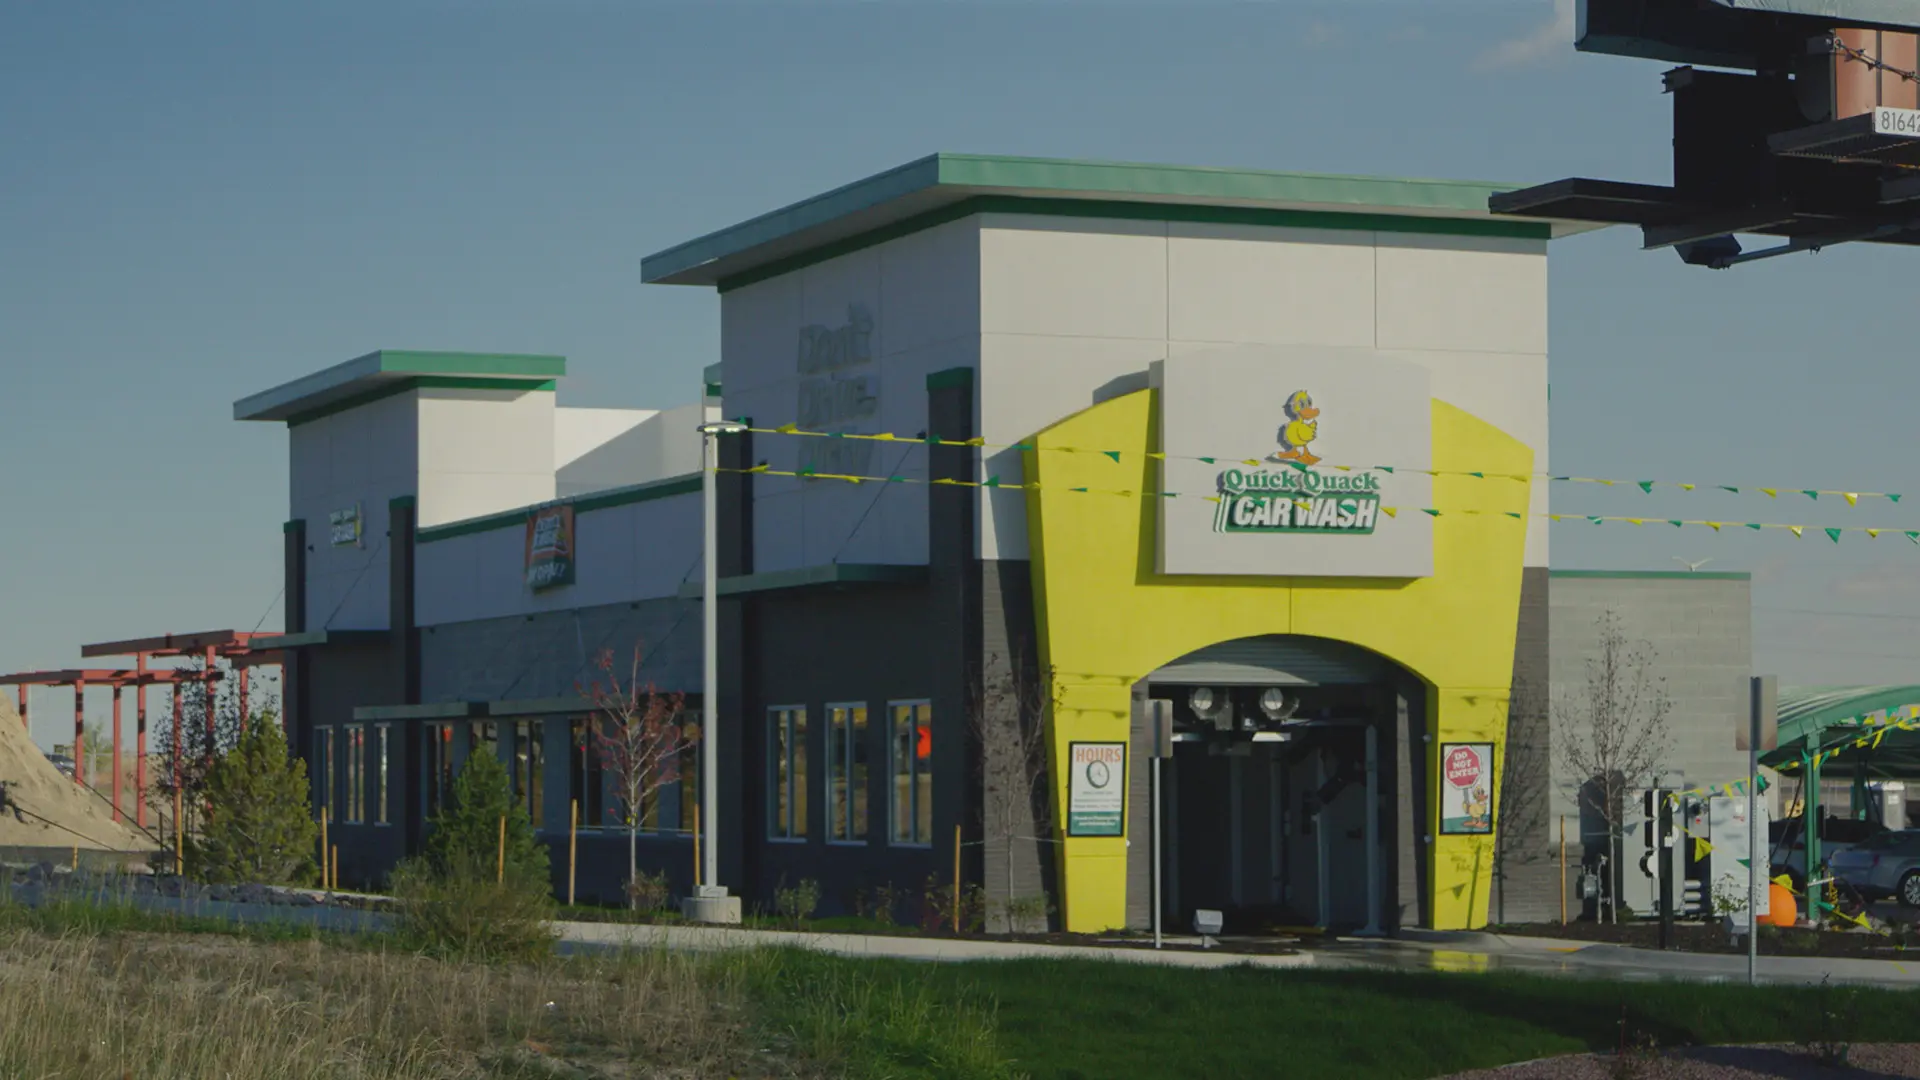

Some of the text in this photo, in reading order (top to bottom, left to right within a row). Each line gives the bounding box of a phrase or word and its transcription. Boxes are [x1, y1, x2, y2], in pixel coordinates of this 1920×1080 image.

[1225, 468, 1380, 496] Quick Quack
[1233, 496, 1377, 528] CAR WASH
[1075, 747, 1121, 763] HOURS
[1454, 751, 1468, 760] DO
[1452, 759, 1472, 770] NOT
[1448, 767, 1479, 779] ENTER
